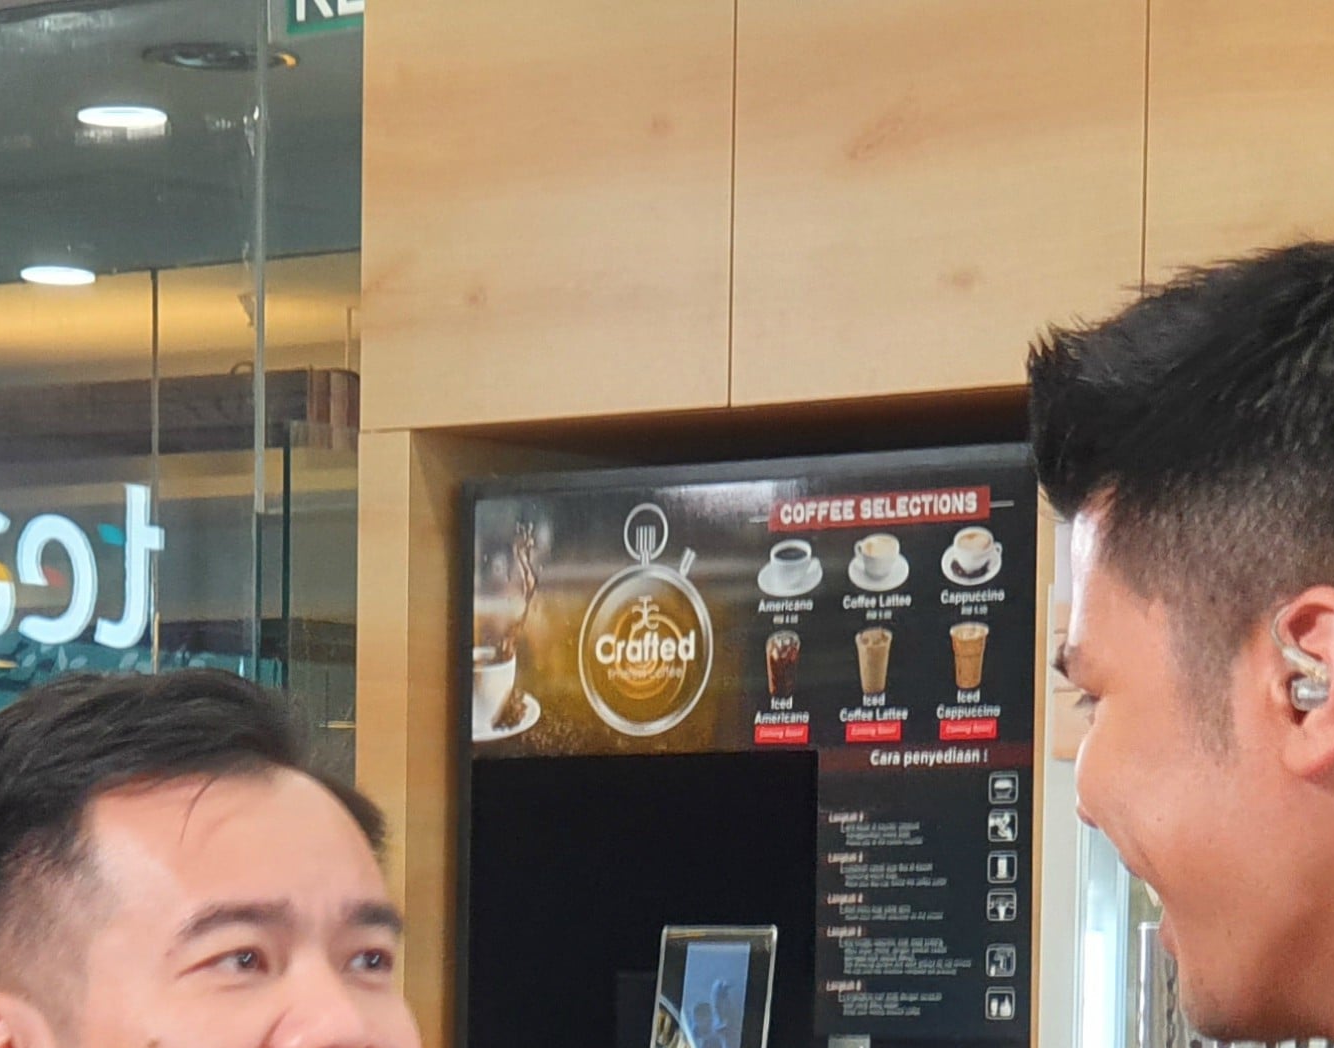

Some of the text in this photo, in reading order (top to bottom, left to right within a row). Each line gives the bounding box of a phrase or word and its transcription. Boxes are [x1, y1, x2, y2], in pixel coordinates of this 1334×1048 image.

[779, 490, 978, 526] COFFEE SELECTIONS
[842, 595, 877, 611] Coffee
[939, 588, 1006, 606] Cappuccino
[757, 599, 814, 614] Americano
[594, 629, 696, 665] Crafted
[770, 696, 793, 710] Iced
[862, 692, 886, 707] Iced
[956, 689, 980, 703] Iced
[754, 710, 810, 725] Americano
[839, 707, 873, 722] Coffee
[936, 703, 1001, 721] Cappuccino
[870, 748, 901, 767] Cara
[903, 746, 981, 768] penyediaan
